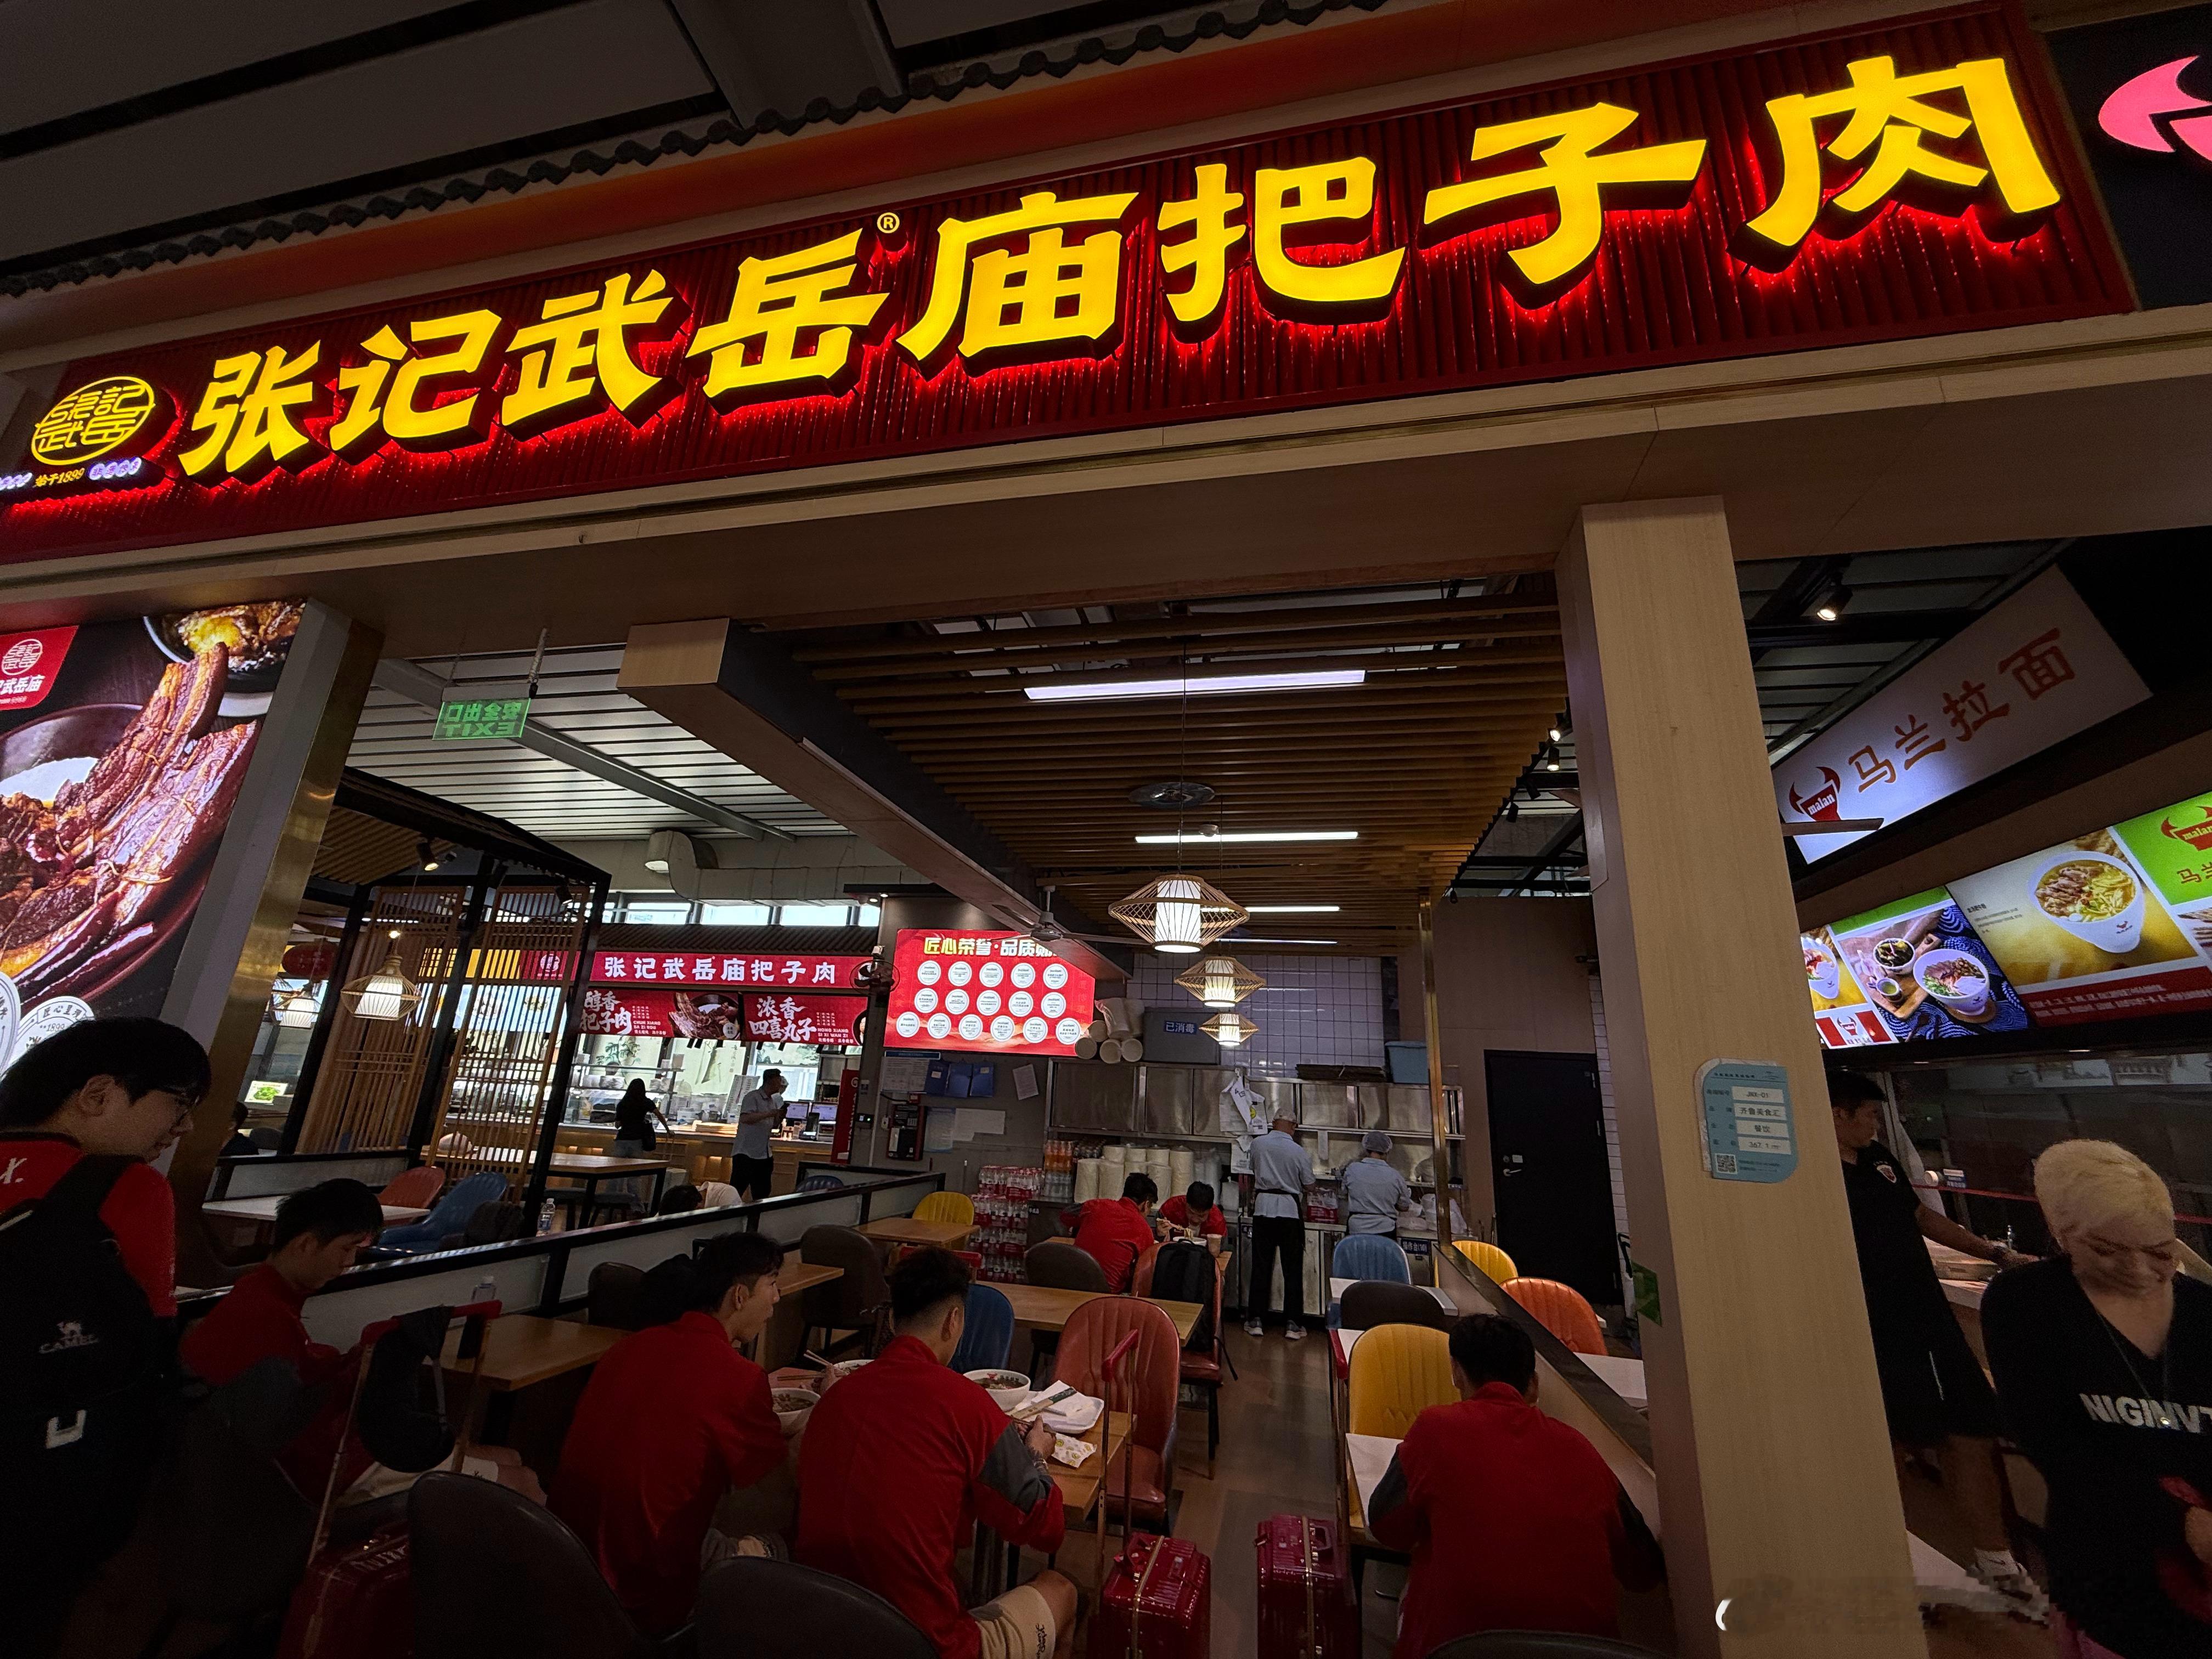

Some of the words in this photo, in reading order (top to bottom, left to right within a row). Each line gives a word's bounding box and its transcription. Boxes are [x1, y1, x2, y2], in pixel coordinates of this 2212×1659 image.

[178, 56, 2060, 476] 张记武岳庙把子肉
[0, 674, 46, 695] 武岳庙
[1848, 627, 2075, 793] 马兰拉面
[1808, 794, 1836, 816] malan
[605, 957, 835, 984] 张记武岳庙把子肉
[584, 990, 623, 1012] 醇香
[756, 996, 809, 1020] 浓香
[580, 1007, 632, 1035] 把子肉
[748, 1016, 816, 1042] 四喜丸子
[1166, 1022, 1195, 1034] 已消毒
